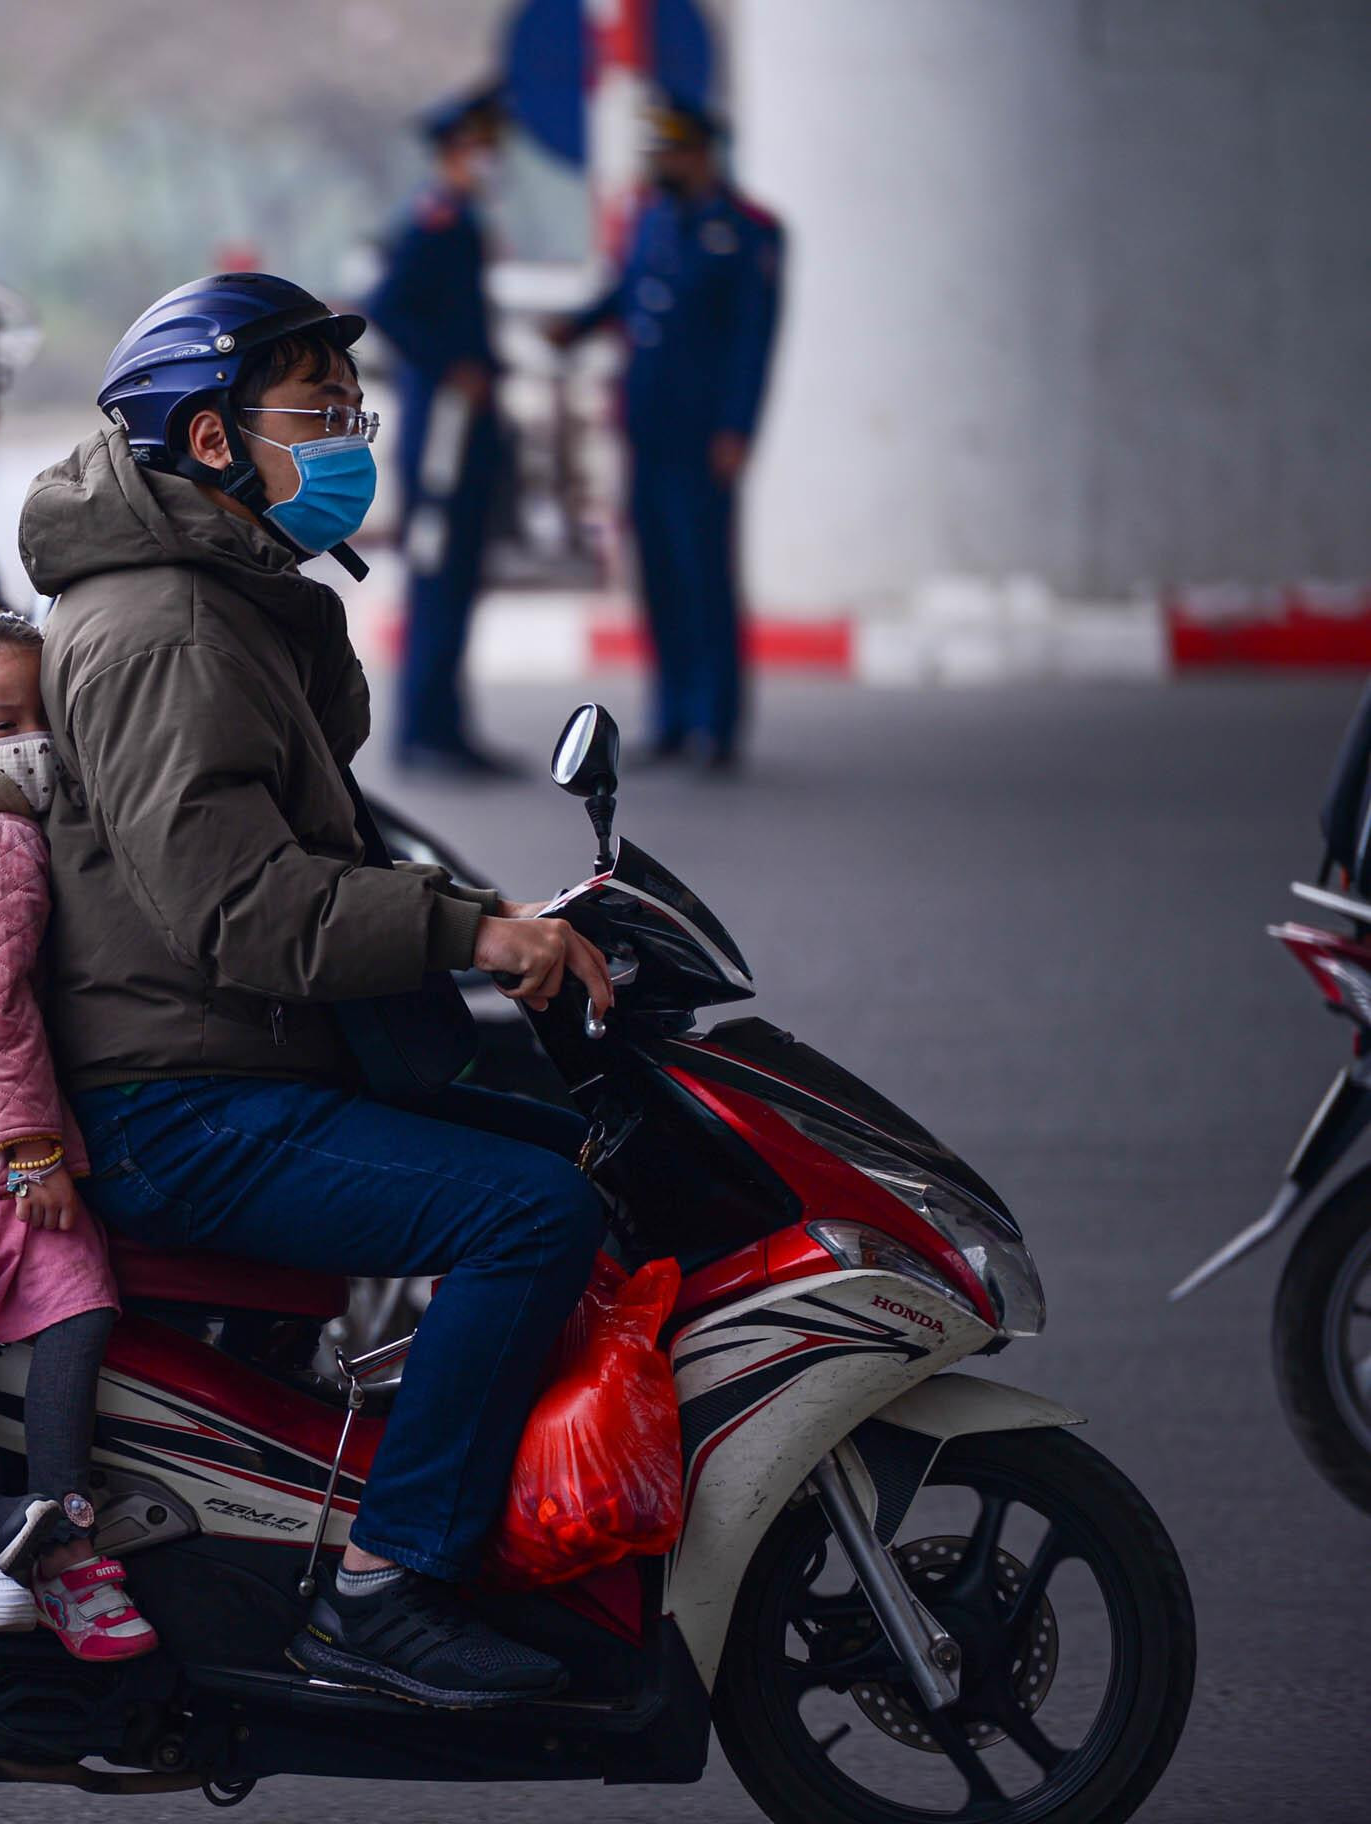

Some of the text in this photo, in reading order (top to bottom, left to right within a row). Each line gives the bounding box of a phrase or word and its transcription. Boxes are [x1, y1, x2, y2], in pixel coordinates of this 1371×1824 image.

[871, 1294, 945, 1334] HONDA
[206, 1506, 295, 1533] FUEL INJECTION
